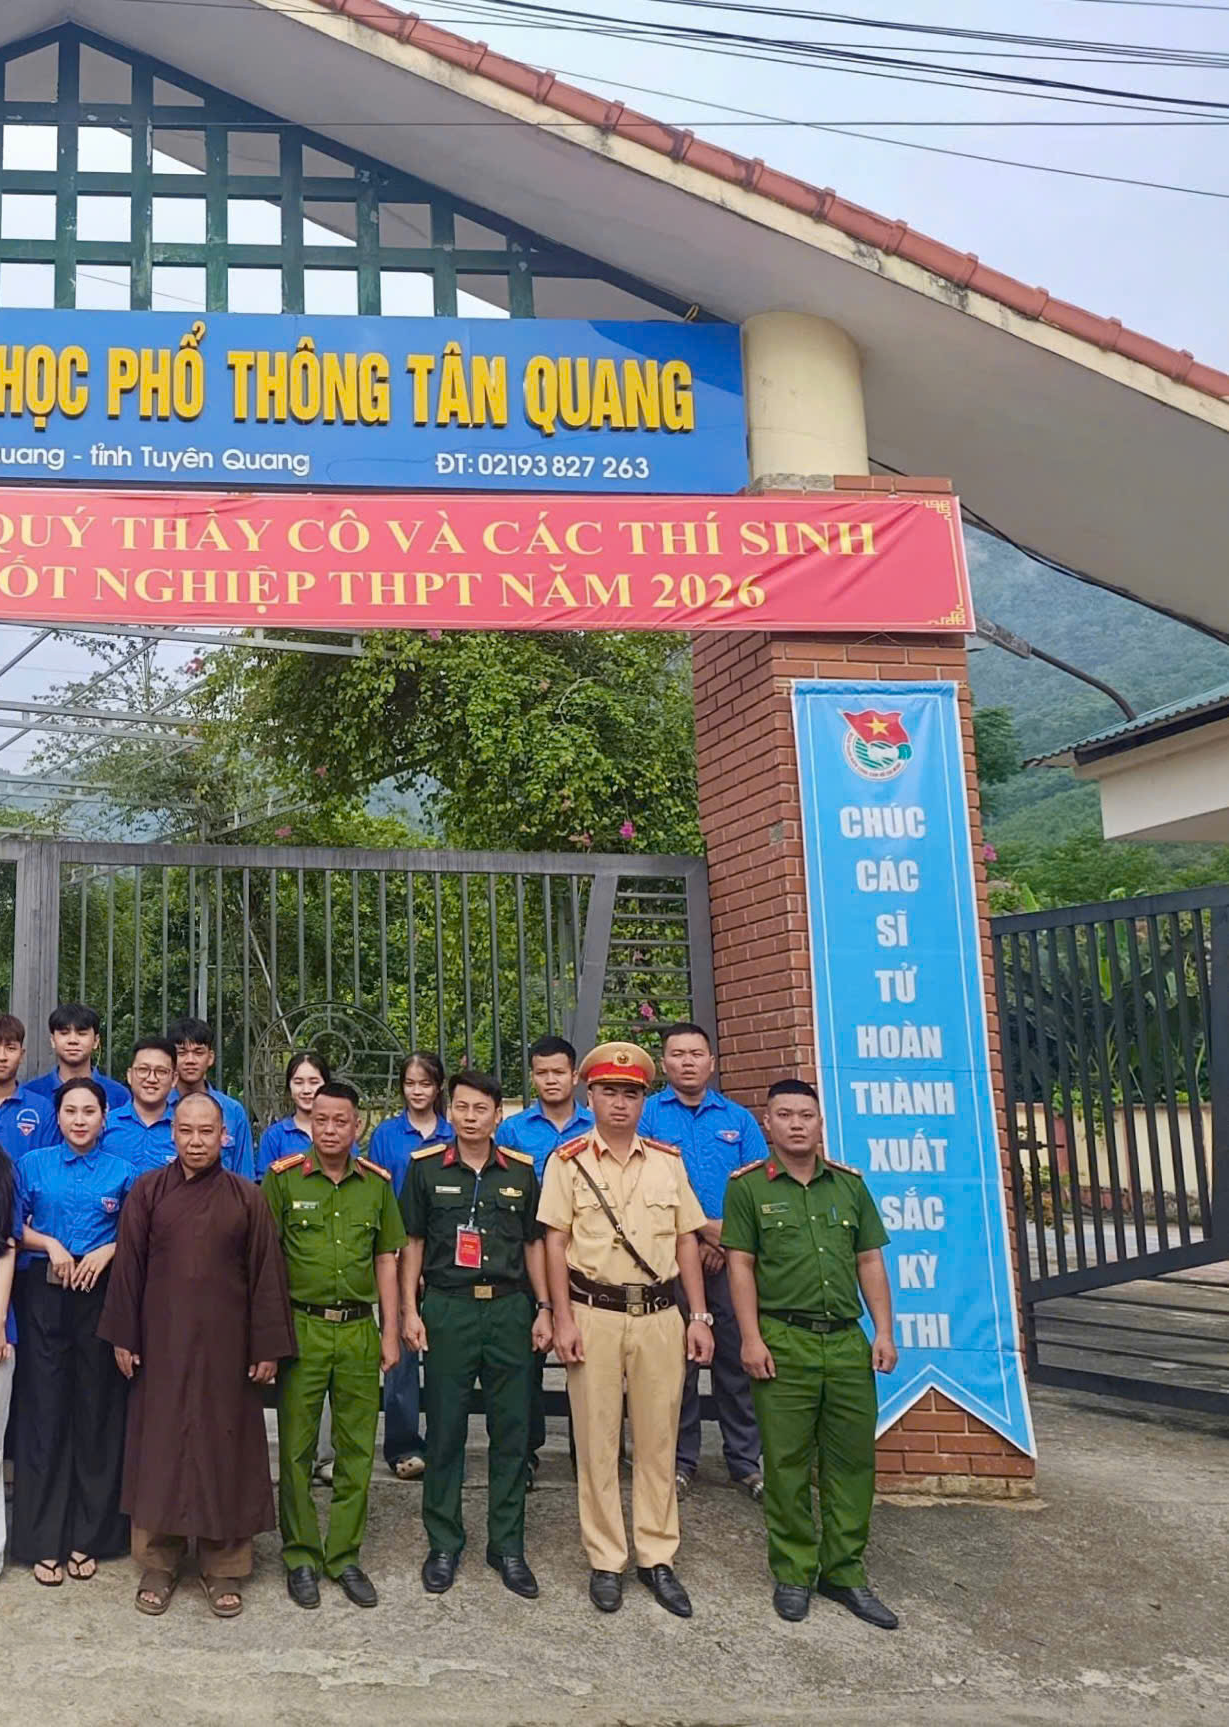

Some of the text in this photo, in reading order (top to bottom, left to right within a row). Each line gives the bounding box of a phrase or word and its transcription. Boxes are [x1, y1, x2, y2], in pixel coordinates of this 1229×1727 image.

[107, 320, 207, 421] PHỔ
[227, 335, 391, 427] THÔNG
[406, 341, 508, 428] TÂN
[524, 355, 696, 437] QUANG
[90, 443, 133, 467] tỉnh
[141, 446, 214, 472] Tuyên
[223, 449, 310, 476] Quang
[435, 453, 650, 479] ĐT: 02193 827 263
[112, 508, 273, 553] THẦY
[287, 509, 371, 554] CÔ
[386, 510, 467, 555] VÀ
[482, 511, 603, 556] CÁC
[619, 511, 724, 557] THÍ
[740, 520, 879, 558] SINH
[93, 564, 317, 614] NGHIỆP
[328, 571, 483, 609] THPT
[499, 563, 634, 609] NĂM
[651, 571, 767, 609] 2026
[839, 802, 926, 839] CHÚC
[855, 855, 920, 893] CÁC
[875, 909, 909, 947] SĨ
[874, 962, 918, 1004] TỬ
[856, 1020, 943, 1059] HOÀN
[850, 1077, 956, 1116] THÀNH
[867, 1128, 948, 1172] XUẤT
[880, 1186, 946, 1231] SẮC
[897, 1249, 938, 1289] KỲ
[895, 1313, 952, 1348] THI
